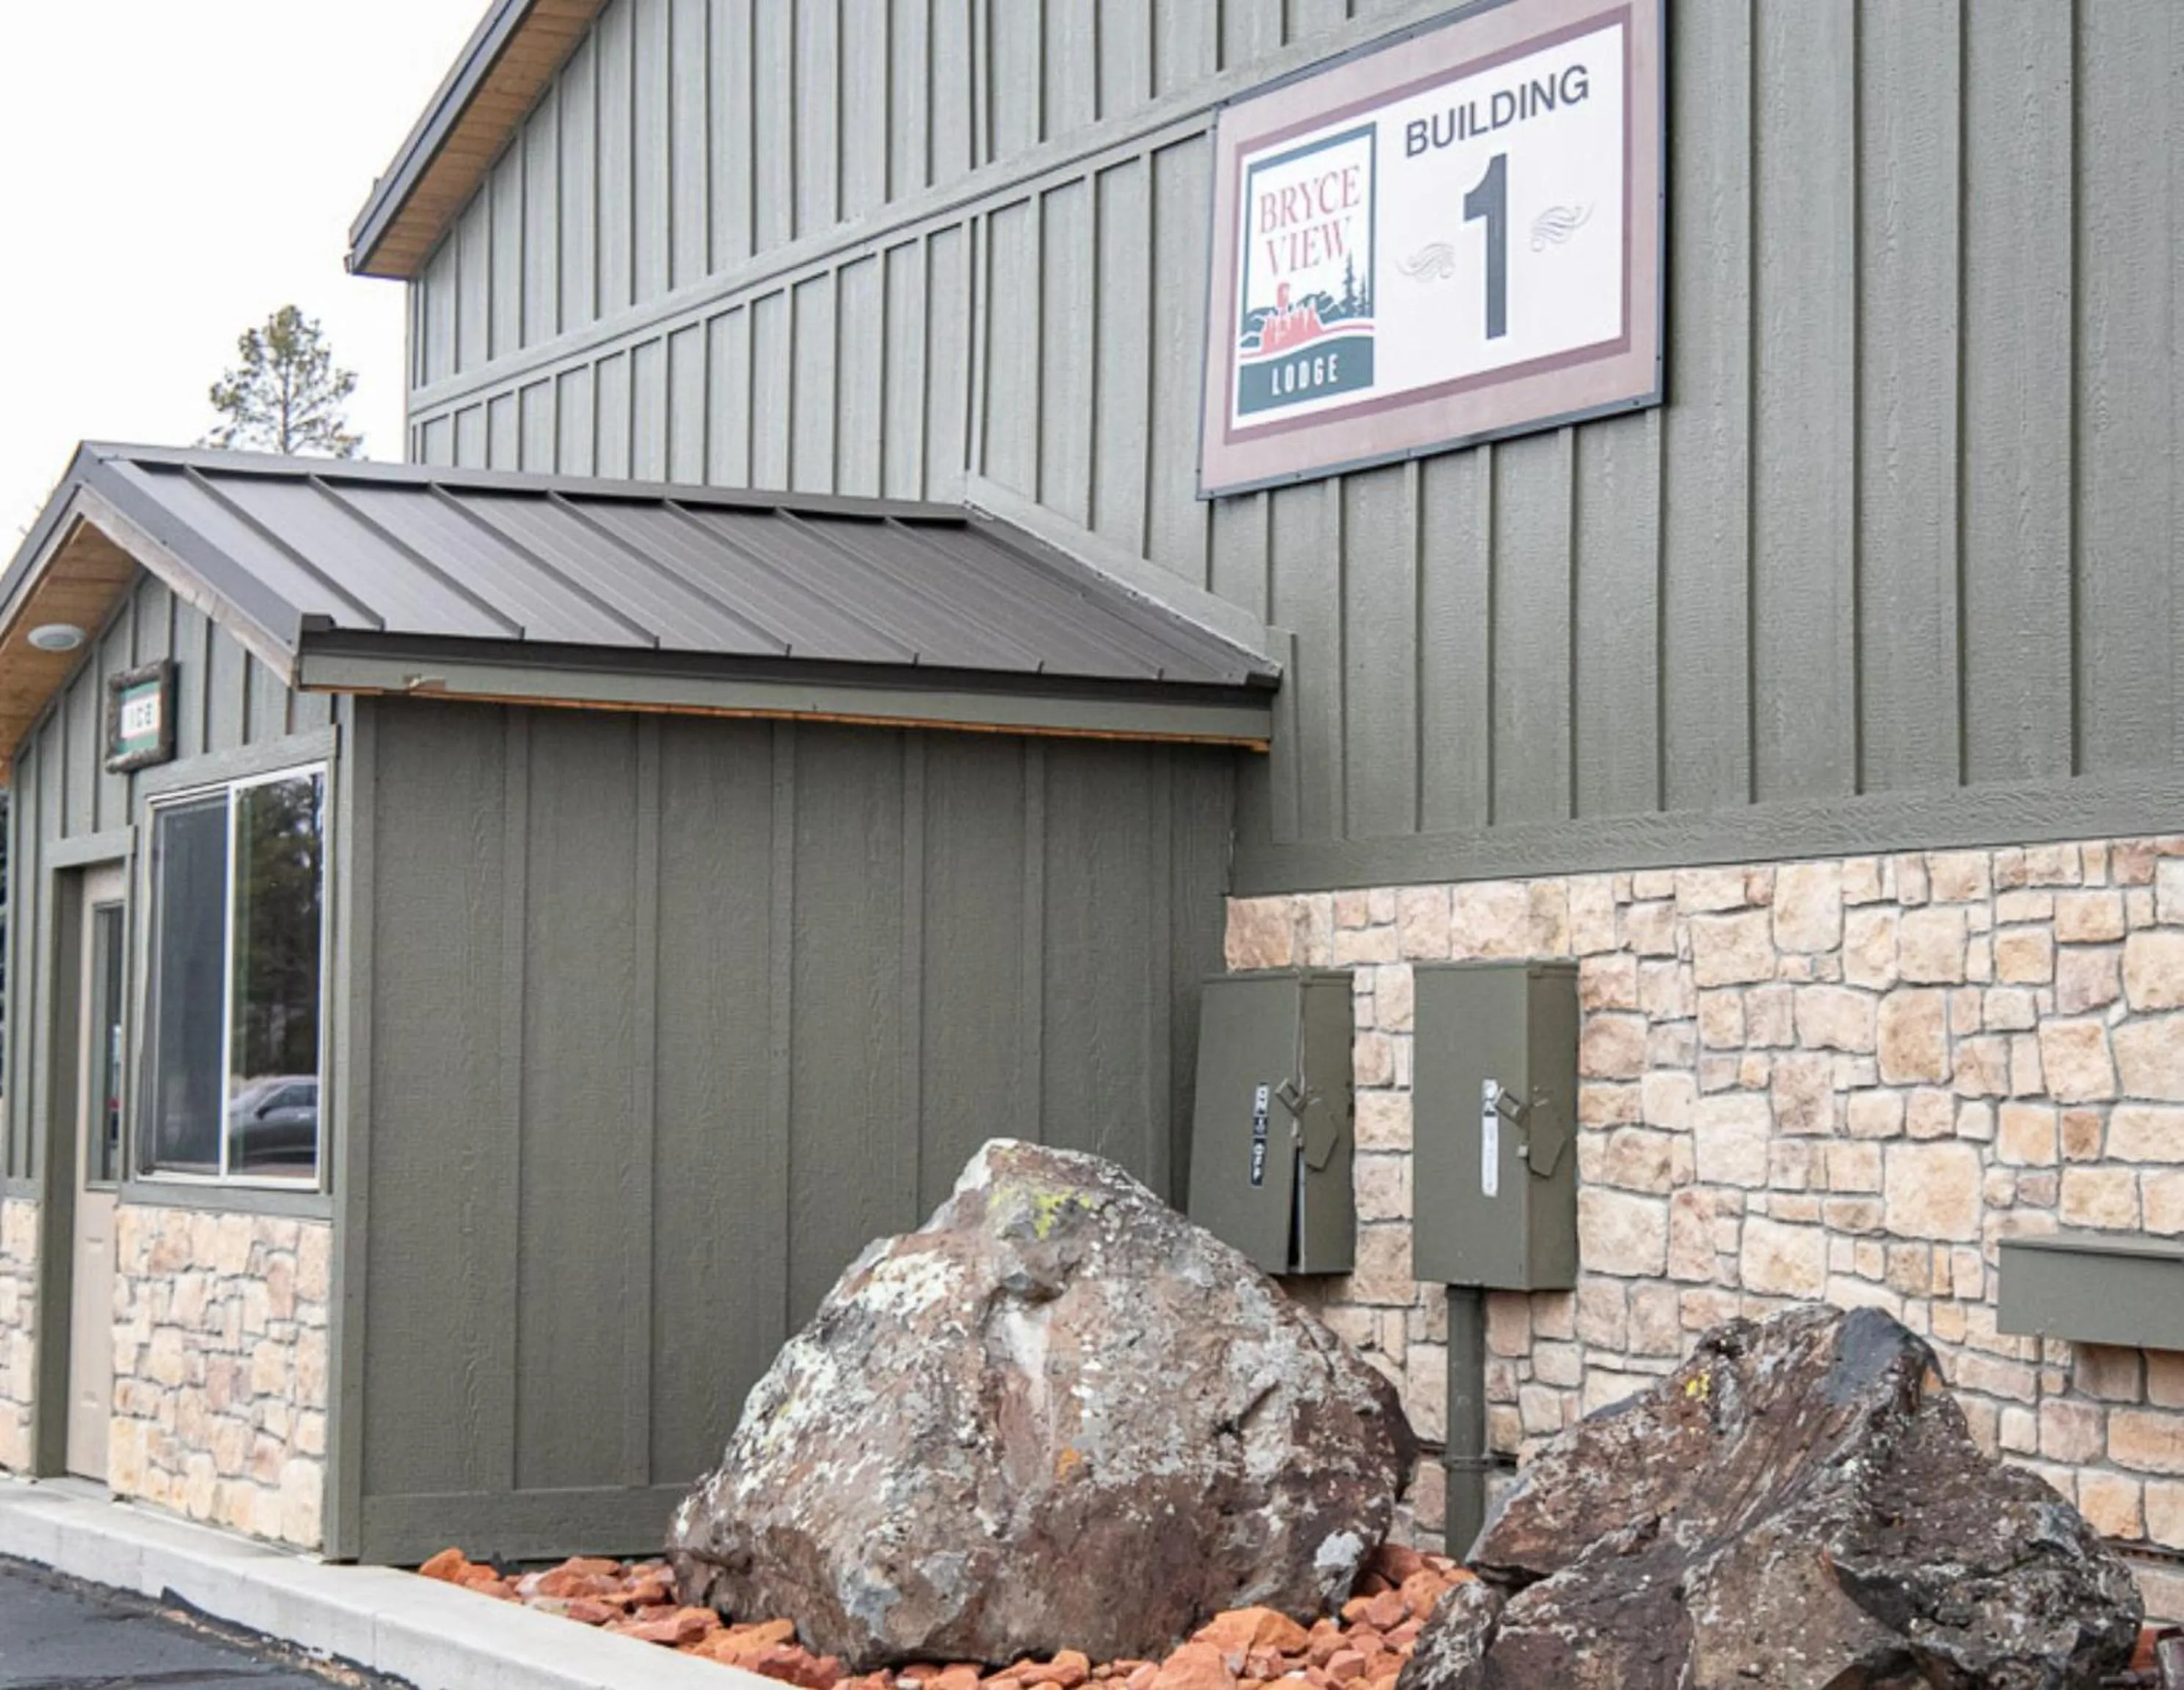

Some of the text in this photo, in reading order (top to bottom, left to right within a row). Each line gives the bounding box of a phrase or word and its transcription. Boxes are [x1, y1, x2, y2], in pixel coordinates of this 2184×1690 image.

[1406, 64, 1588, 158] BUILDING
[1260, 164, 1361, 234] BRYCE
[1266, 216, 1351, 276] VIEW
[1463, 153, 1507, 340] 1
[1272, 353, 1338, 396] LODGE
